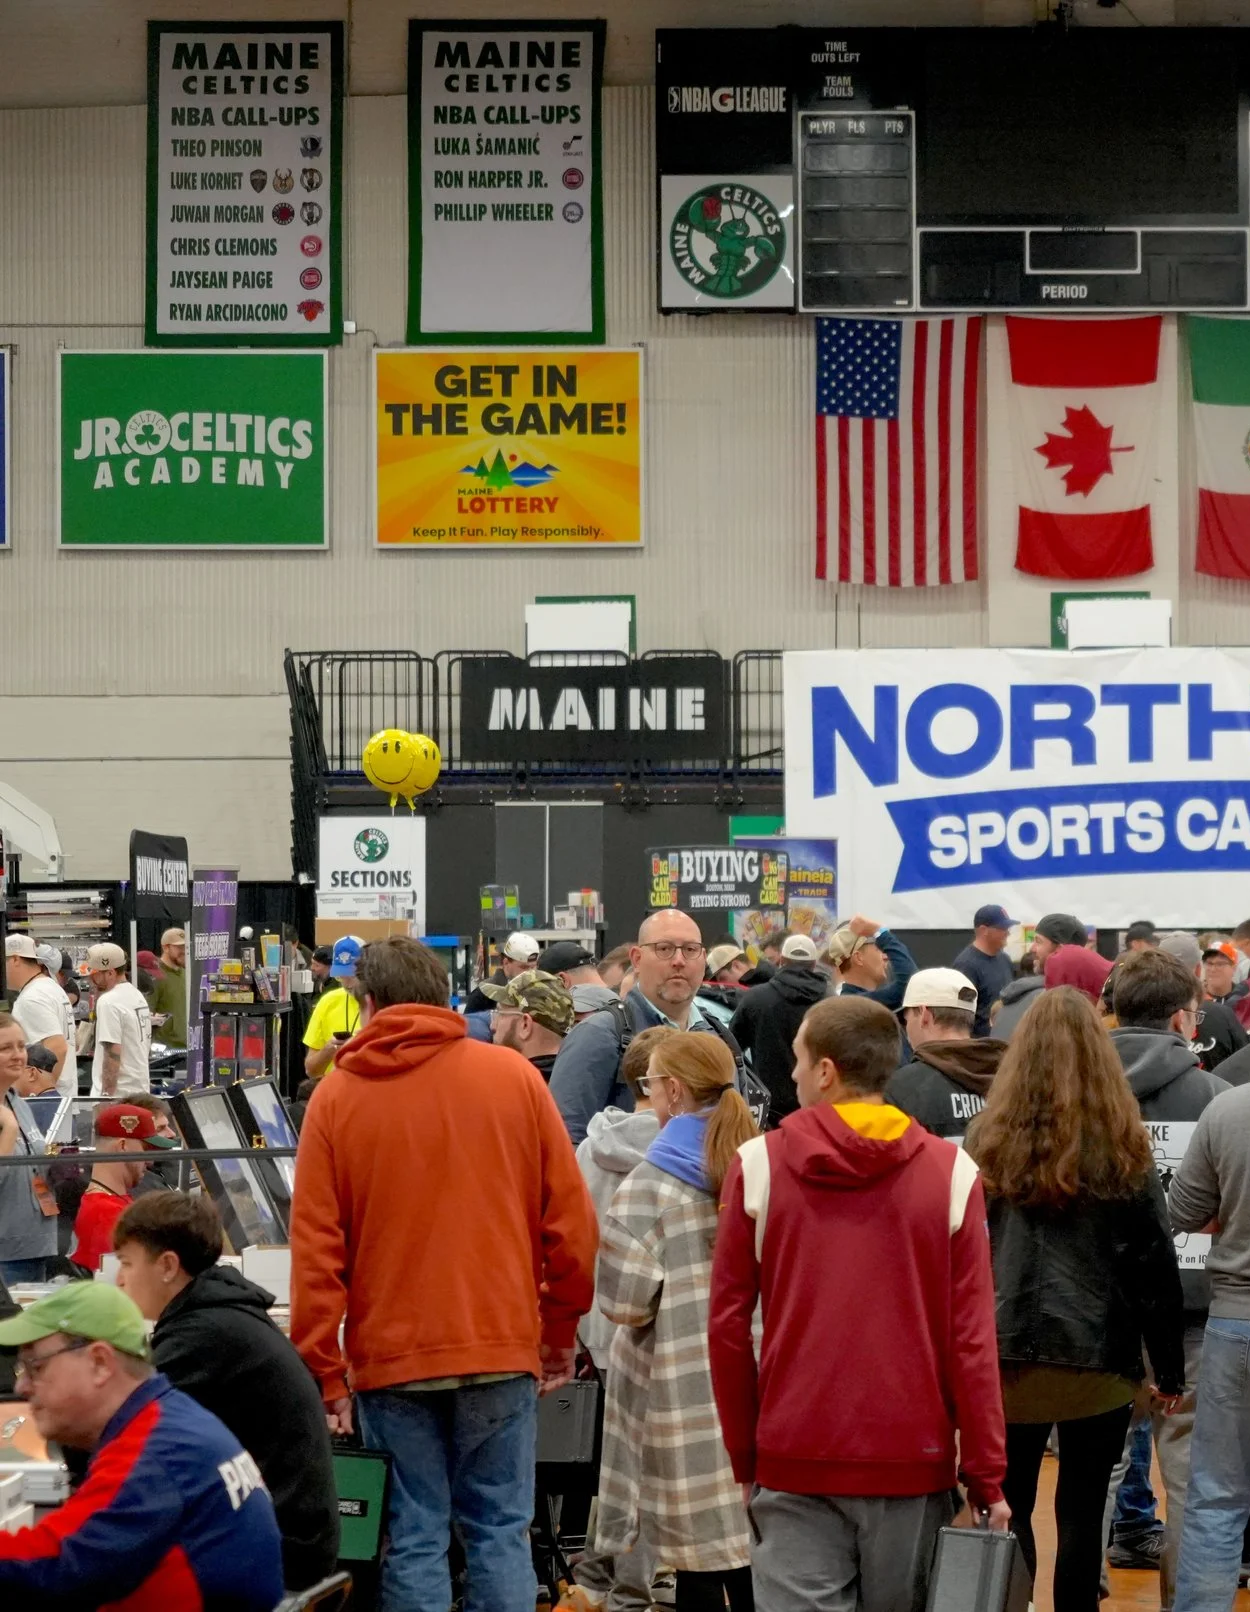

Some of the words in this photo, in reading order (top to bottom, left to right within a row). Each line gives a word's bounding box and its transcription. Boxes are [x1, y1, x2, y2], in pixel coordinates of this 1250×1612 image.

[172, 42, 319, 70] MAINE
[434, 41, 581, 68] MAINE
[825, 42, 847, 51] TIME
[811, 53, 836, 63] OUTS
[839, 53, 860, 62] LEFT
[182, 75, 310, 95] CELTICS
[445, 74, 571, 93] CELTICS
[826, 76, 851, 86] TEAM
[823, 87, 854, 97] FOULS
[171, 106, 215, 126] NBA
[222, 107, 320, 127] CALL-UPS
[433, 105, 478, 125] NBA
[483, 105, 581, 125] CALL-UPS
[809, 121, 836, 133] PLYR
[848, 121, 866, 133] FLS
[885, 121, 904, 133] PTS
[171, 139, 206, 157] THEO
[211, 139, 262, 157] PINSON
[434, 137, 471, 156] LUKA
[171, 172, 197, 190] LUKE
[201, 172, 243, 190] KORNET
[434, 170, 463, 189] RON
[467, 170, 522, 189] HARPER
[527, 170, 549, 189] JR.
[171, 205, 210, 223] JUWAN
[214, 205, 264, 223] MORGAN
[434, 203, 487, 222] PHILLIP
[492, 203, 554, 222] WHEELER
[720, 187, 781, 236] CELTICS
[170, 238, 210, 256] CHRIS
[215, 238, 277, 256] CLEMONS
[670, 222, 705, 285] MAINE
[170, 271, 228, 289] JAYSEAN
[233, 271, 273, 288] PAIGE
[1042, 286, 1088, 299] PERIOD
[169, 303, 202, 321] RYAN
[206, 303, 288, 321] ARCIDIACONO
[434, 364, 520, 399] GET
[530, 364, 577, 398] IN
[129, 412, 168, 432] CELTICS
[385, 402, 469, 436] THE
[479, 402, 627, 436] GAME!
[169, 412, 313, 459] CELTICS
[93, 457, 294, 490] ACADEMY
[457, 488, 494, 496] MAINE
[457, 497, 560, 515] LOTTERY
[412, 526, 446, 540] Keep
[448, 527, 457, 537] It
[459, 526, 488, 537] Fun.
[490, 526, 518, 540] Play
[521, 526, 605, 540] Responsibly.
[488, 688, 706, 731] MAINE
[927, 800, 1166, 870] SPORTS
[652, 854, 668, 876] BIG
[680, 851, 759, 883] BUYING
[136, 855, 162, 896] BUYING
[163, 859, 189, 898] CENTER
[331, 869, 412, 888] SECTIONS
[653, 876, 670, 891] CAN
[763, 876, 778, 890] CAN
[691, 895, 718, 908] PAYING
[720, 894, 750, 907] STRONG
